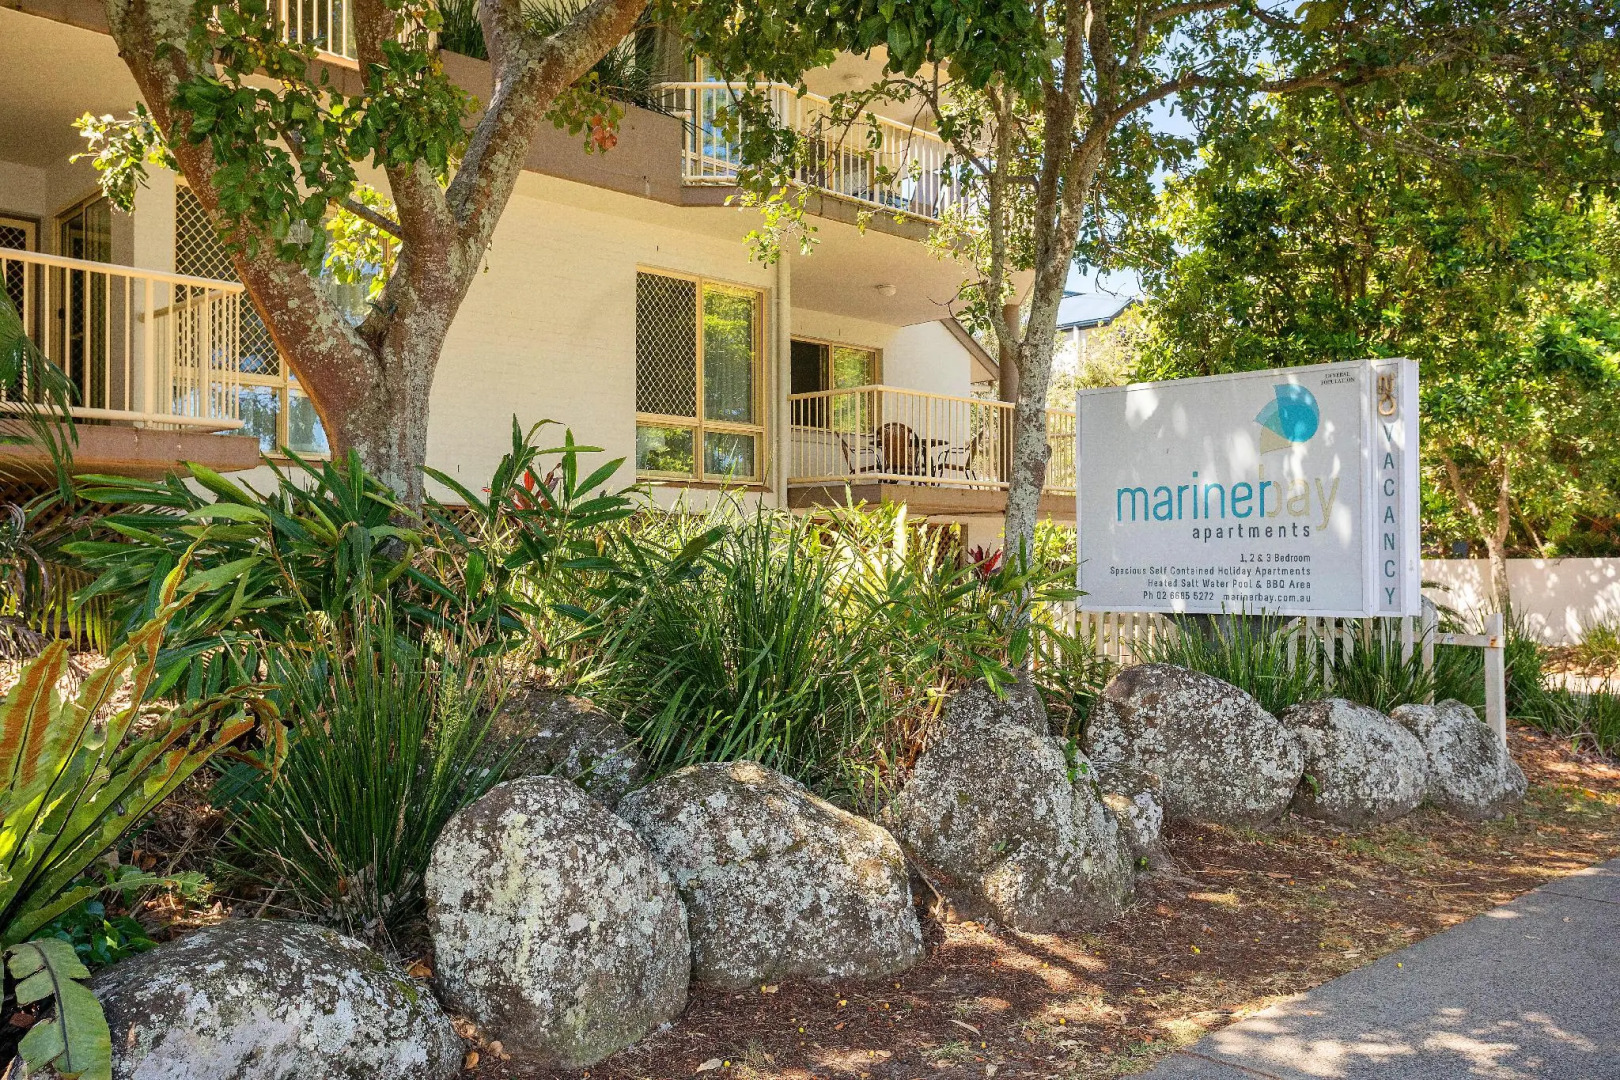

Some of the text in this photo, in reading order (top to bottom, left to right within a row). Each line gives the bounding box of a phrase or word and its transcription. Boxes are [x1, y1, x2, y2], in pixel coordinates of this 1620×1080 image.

[1383, 424, 1396, 605] VACANCY
[1192, 523, 1310, 543] apartments
[1249, 554, 1255, 562] 2
[1257, 554, 1264, 562] &
[1266, 554, 1272, 562] 3
[1274, 554, 1311, 562] Bedroom
[1110, 566, 1311, 577] Spacious Self Contained Holiday Apartments
[1147, 579, 1311, 589] Heated Salt Water Pool & BBQ Area
[1143, 590, 1311, 603] Ph 02 6685 5272 marinerbay.com.au
